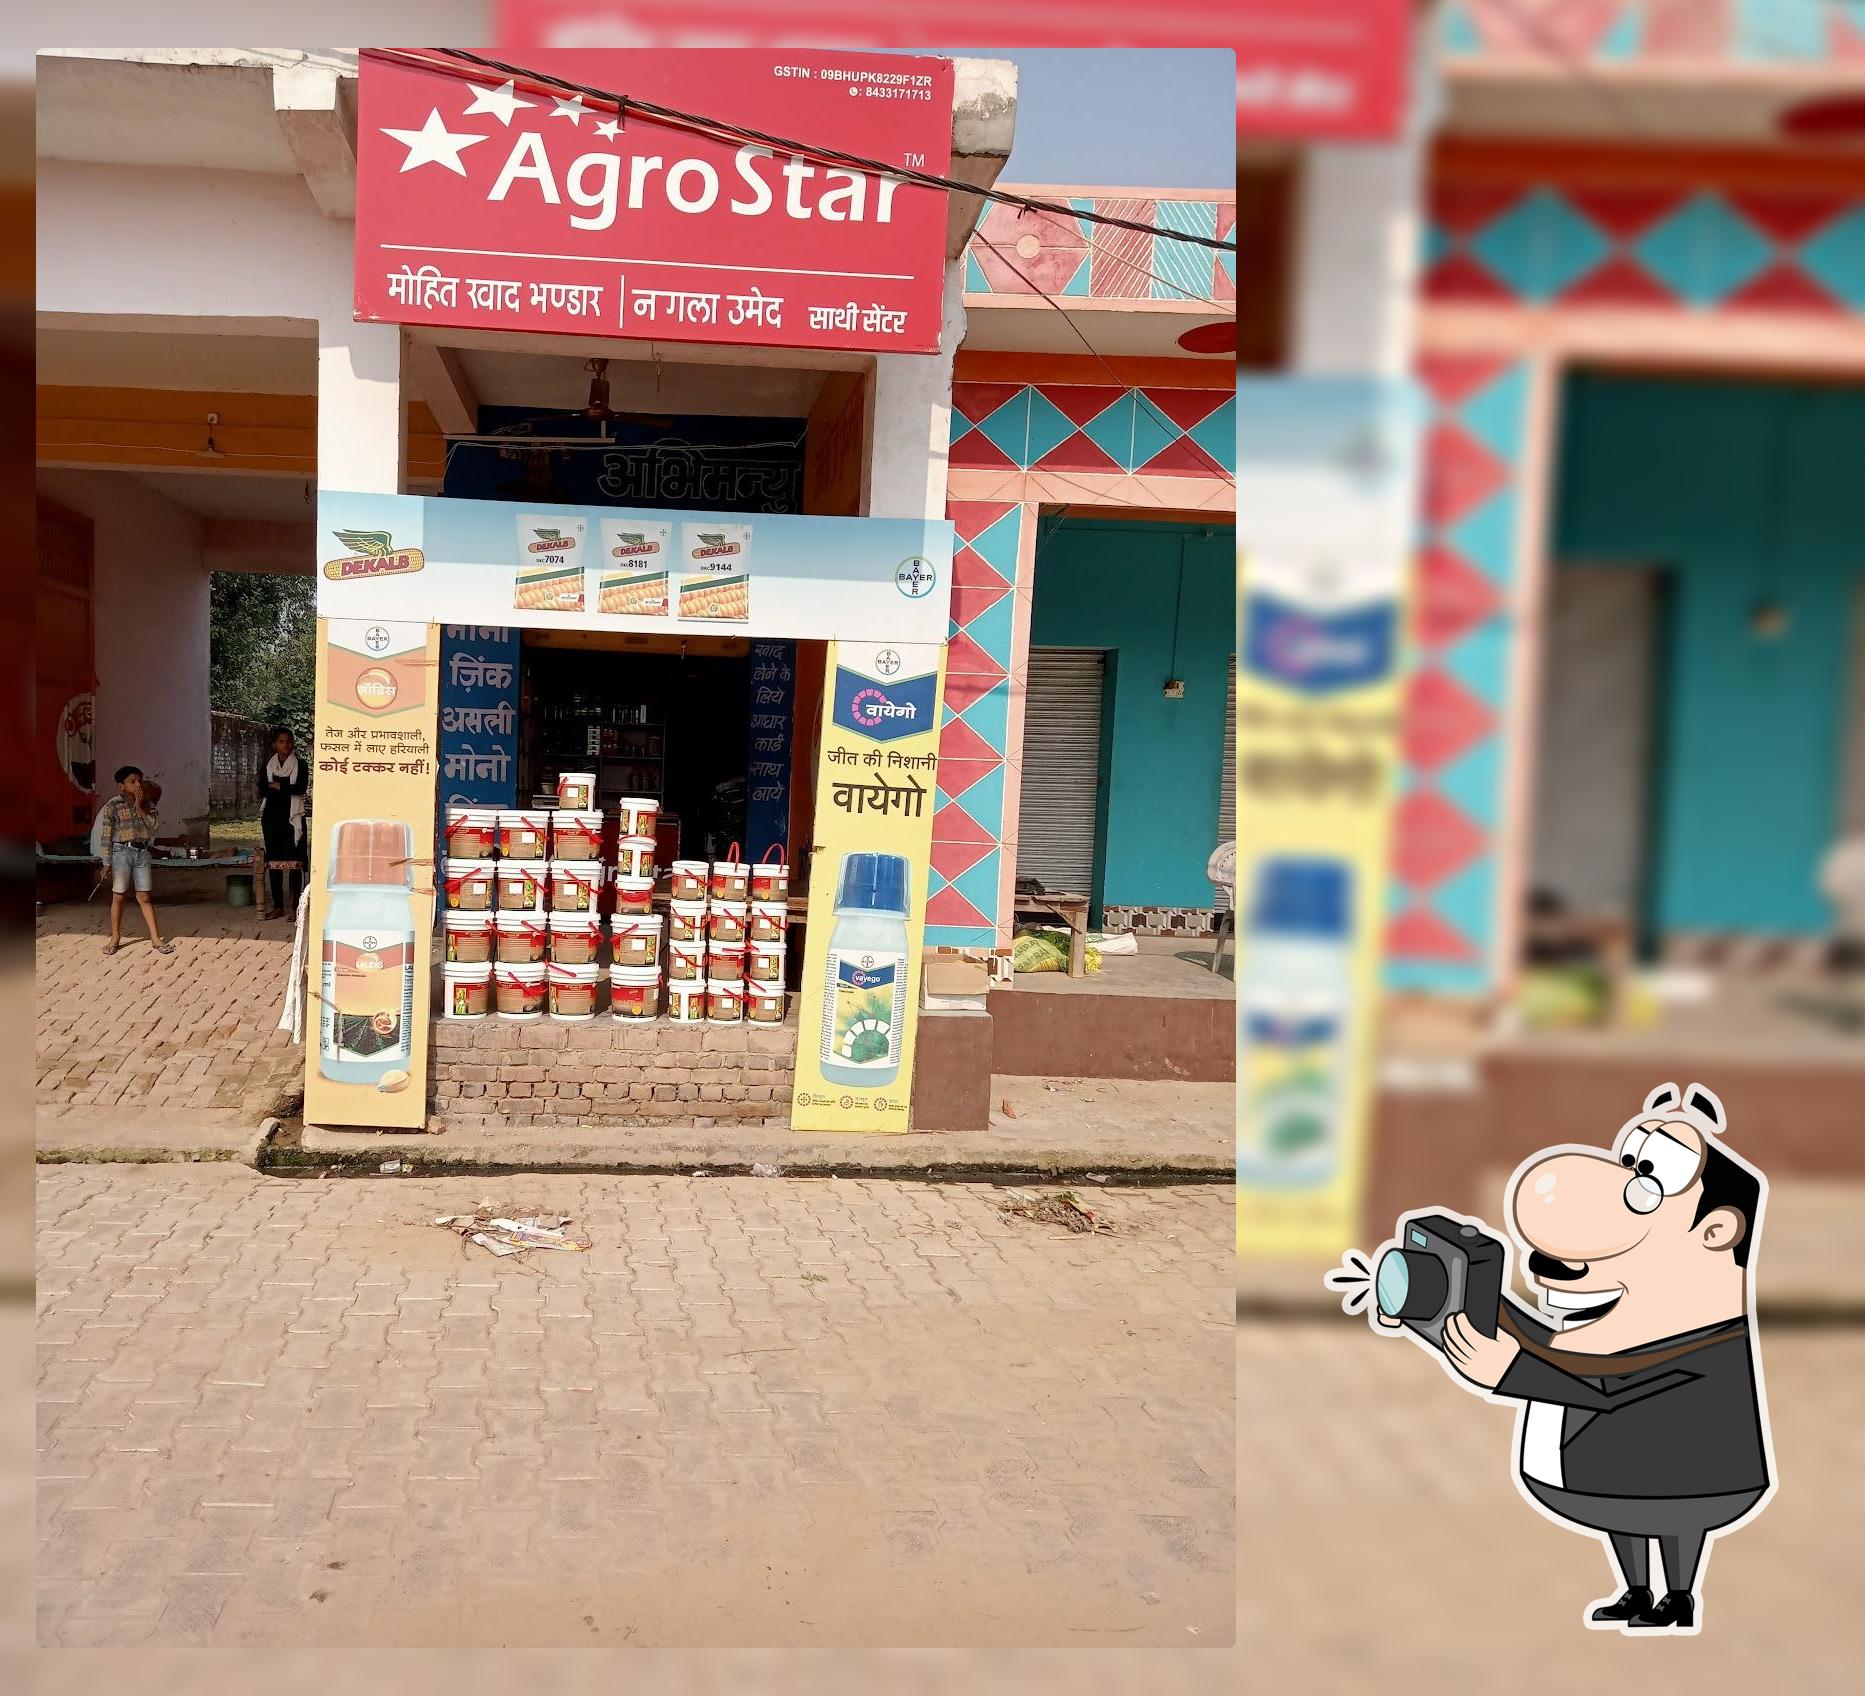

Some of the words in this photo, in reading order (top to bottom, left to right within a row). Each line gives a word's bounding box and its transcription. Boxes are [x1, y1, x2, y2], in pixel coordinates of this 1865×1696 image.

[774, 65, 810, 78] GSTIN
[820, 69, 933, 87] 09BHUPK8229F1ZR
[866, 86, 932, 101] 8433171713
[904, 153, 925, 168] TM
[486, 131, 910, 231] AgroStar
[386, 264, 461, 310] मोहित
[465, 278, 523, 313] खाद
[529, 282, 604, 317] भण्डार
[726, 286, 785, 329] उमेद
[808, 302, 858, 332] साथी
[861, 303, 908, 334] सेंटर
[536, 540, 569, 552] DEKALB
[620, 544, 653, 555] DEKALB
[700, 545, 734, 557] DEKALB
[340, 554, 410, 577] DEKALB
[898, 573, 933, 581] BAYER
[442, 700, 516, 736] असली
[866, 700, 917, 720] वायेगो
[325, 726, 344, 738] तेज
[347, 727, 367, 739] और
[320, 743, 351, 753] फसल
[353, 741, 362, 753] में
[366, 744, 387, 755] लाए
[390, 742, 430, 755] हरियाली
[318, 757, 350, 775] कोई
[352, 762, 396, 773] टक्कर
[444, 743, 512, 783] मोनो
[827, 746, 859, 766] जीत
[863, 749, 884, 768] की
[887, 750, 938, 771] निशानी
[832, 772, 928, 818] वायेगो
[855, 976, 881, 984] vayego
